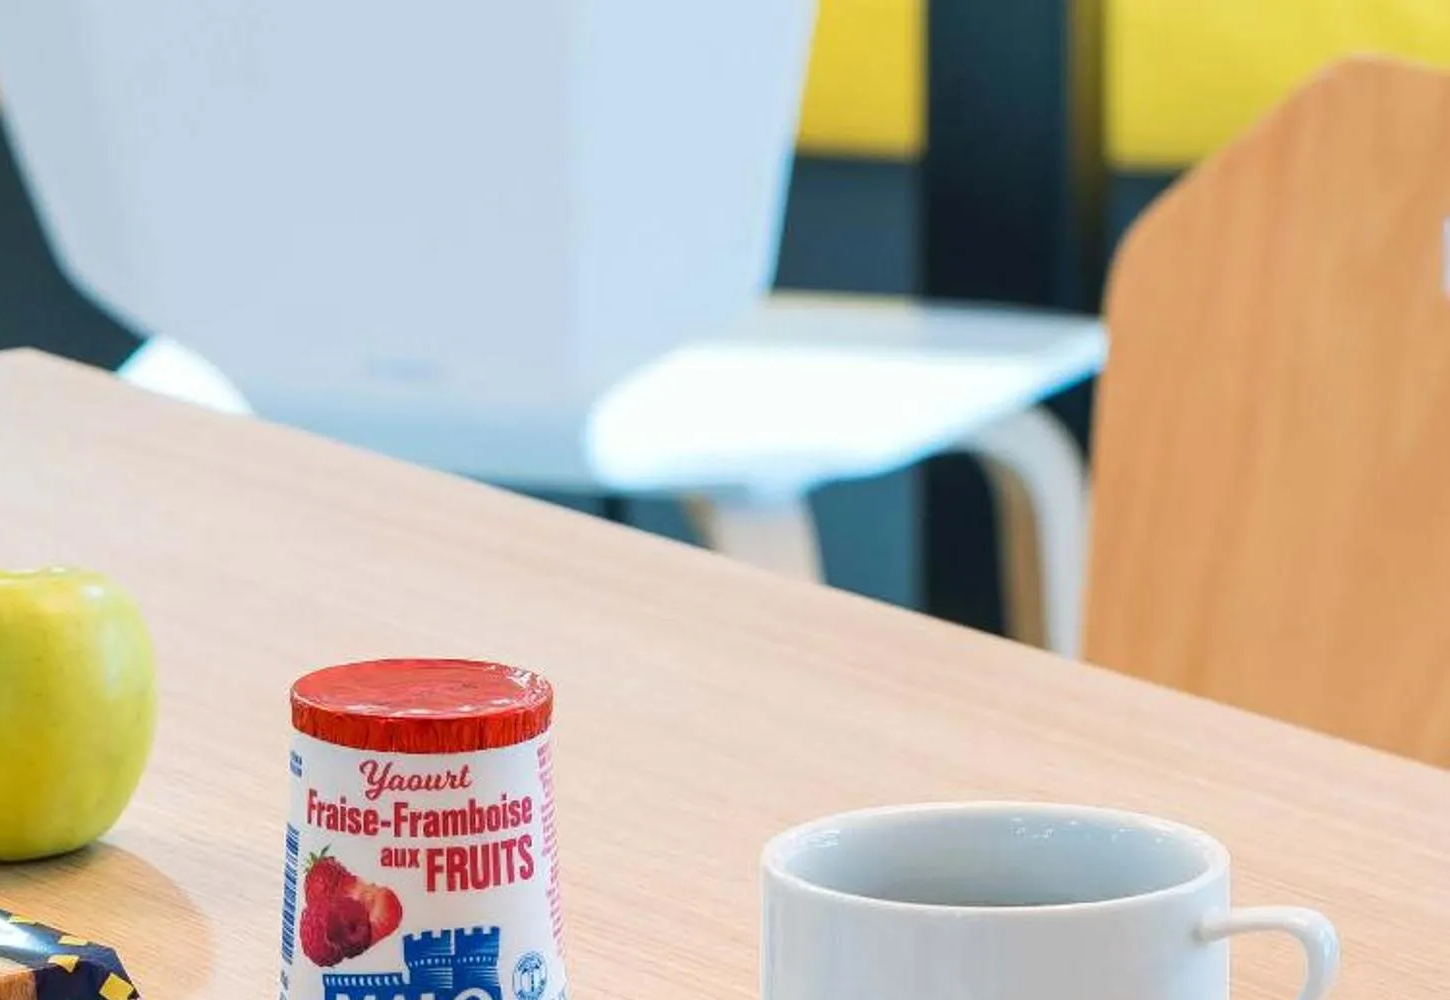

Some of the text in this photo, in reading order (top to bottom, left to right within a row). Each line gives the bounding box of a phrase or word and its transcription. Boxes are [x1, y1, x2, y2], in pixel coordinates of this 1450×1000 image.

[359, 760, 472, 800] Yaourt
[306, 788, 533, 838] Fraise-Framboise
[380, 834, 535, 893] aux FRUITS
